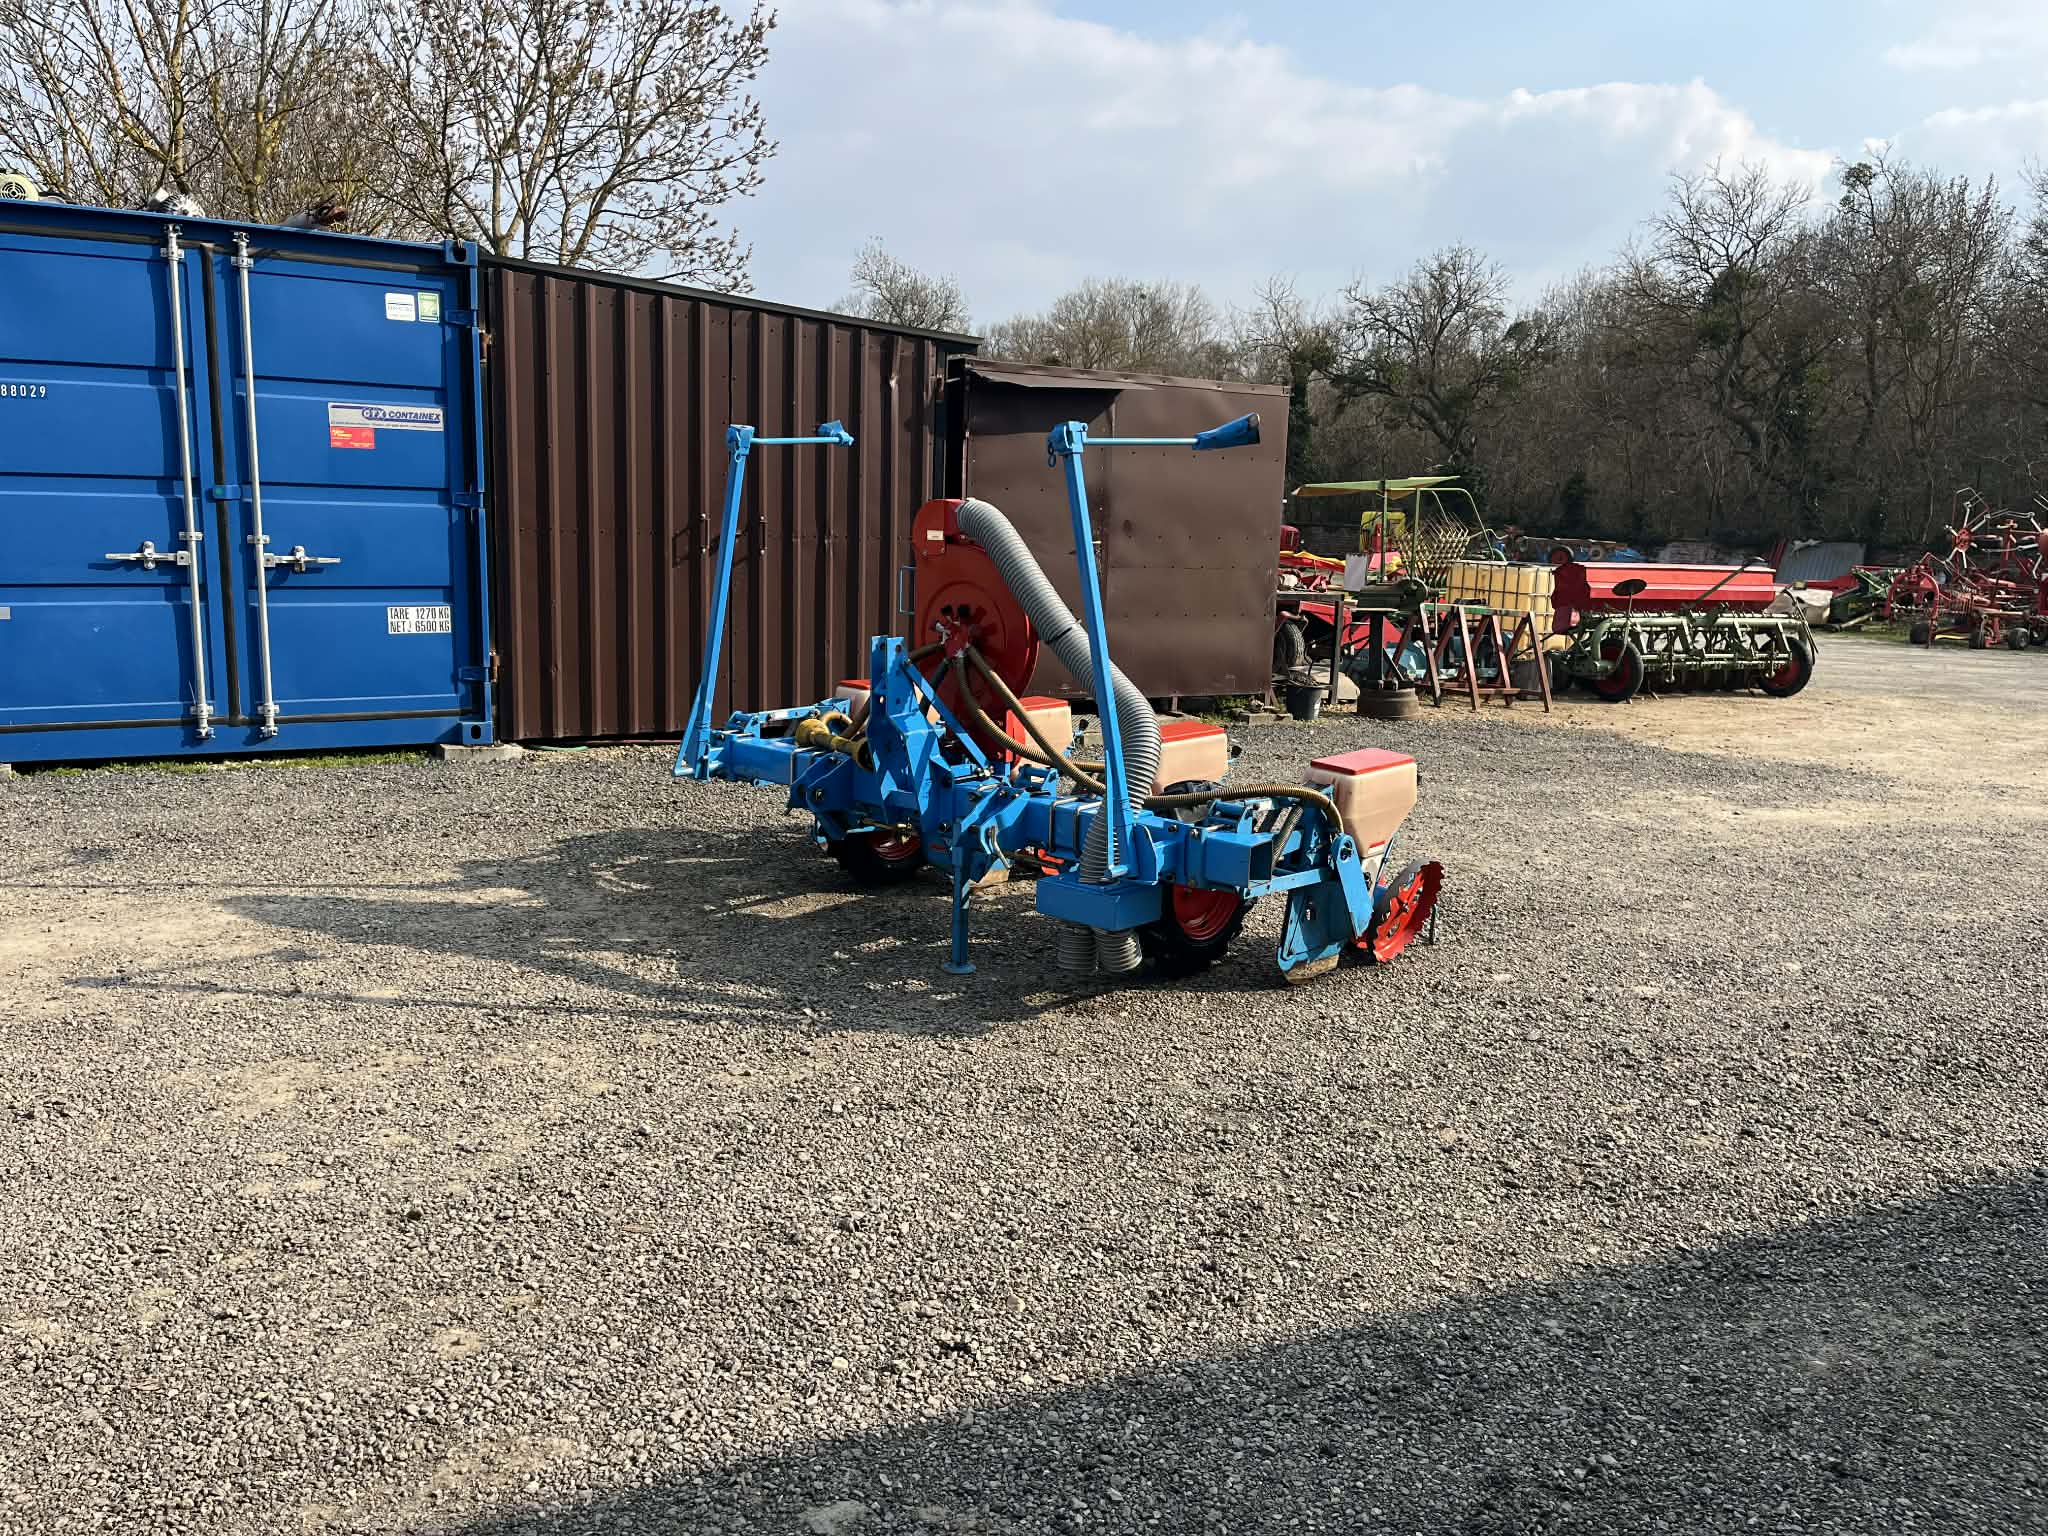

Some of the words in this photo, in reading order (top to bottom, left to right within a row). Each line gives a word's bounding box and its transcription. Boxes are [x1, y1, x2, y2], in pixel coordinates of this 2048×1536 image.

[0, 384, 46, 398] 88029
[388, 410, 441, 421] CONTAINEX
[389, 607, 410, 620] TARE
[416, 607, 437, 620] 1270
[438, 607, 450, 619] KG
[415, 620, 437, 633] 6500
[439, 620, 450, 633] KG
